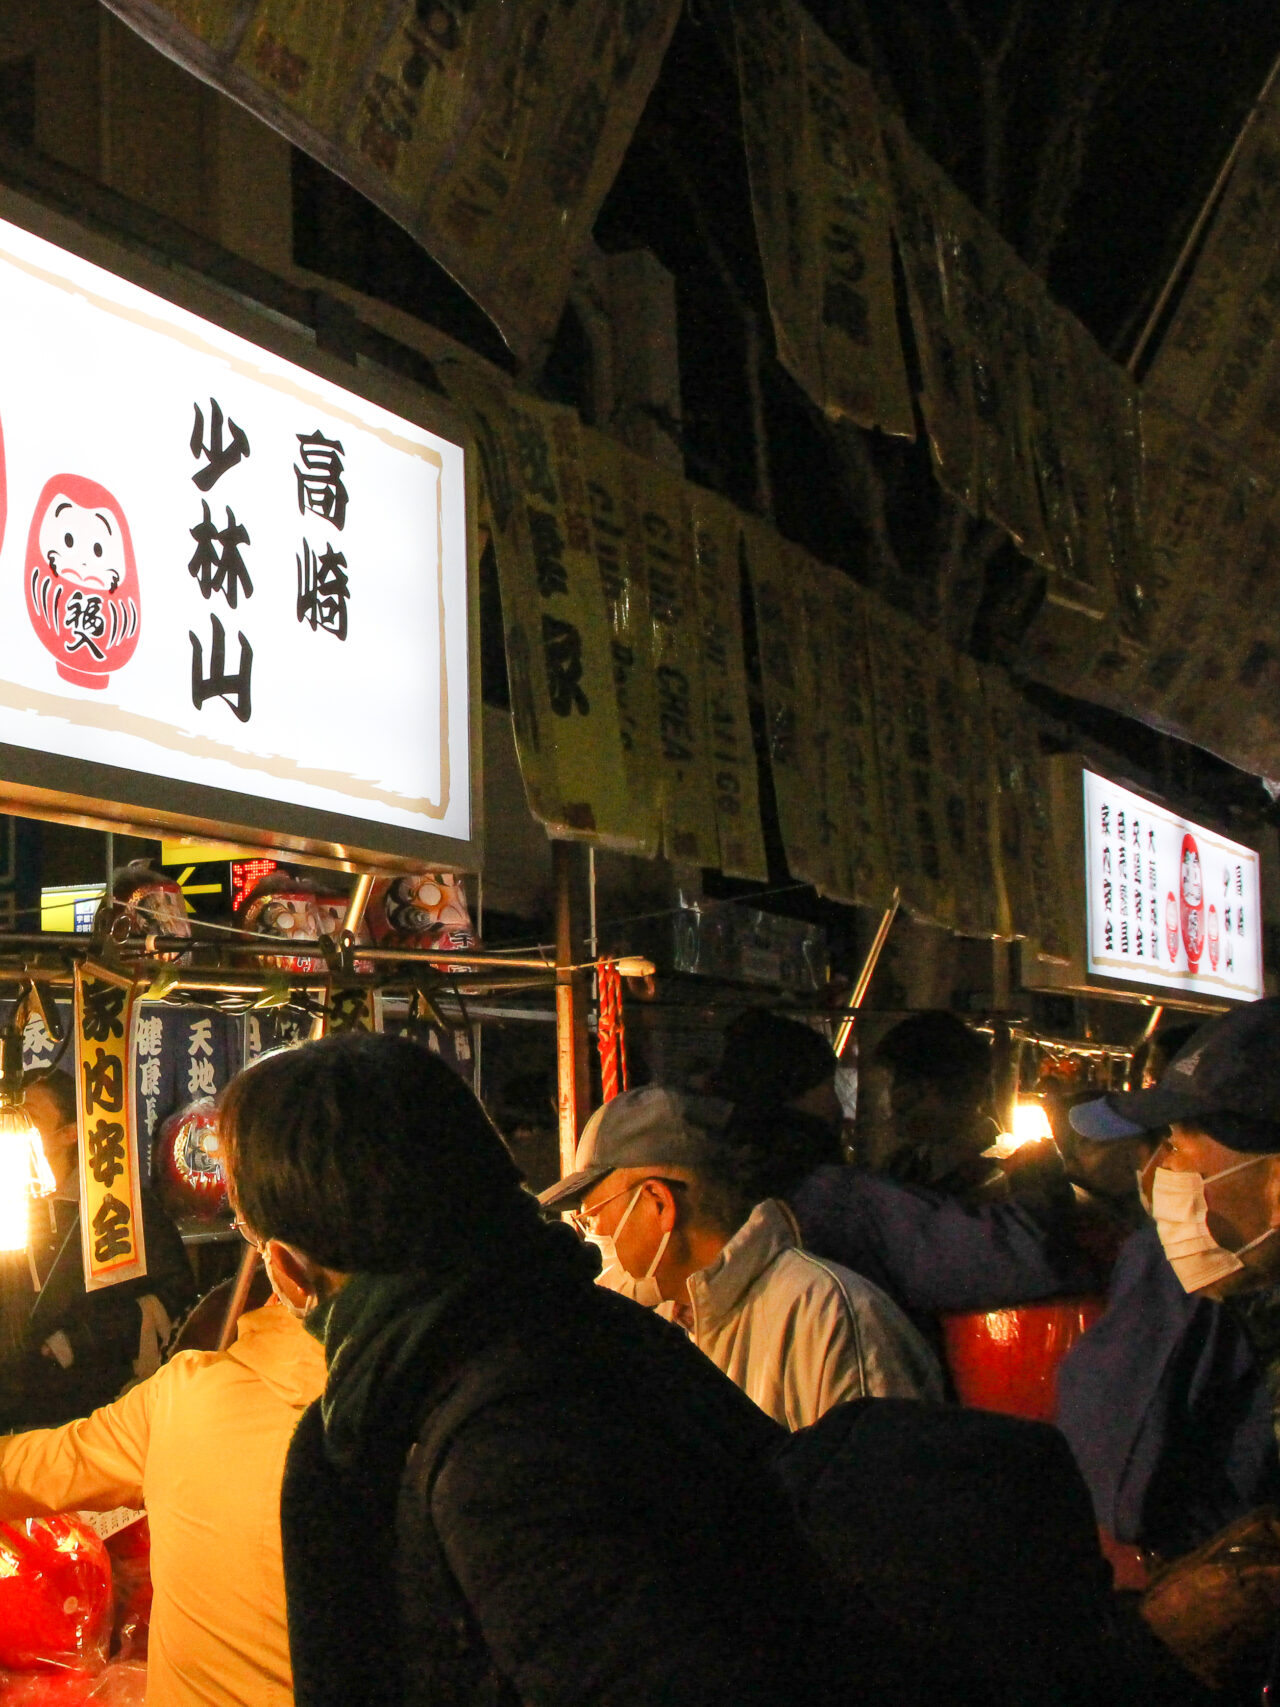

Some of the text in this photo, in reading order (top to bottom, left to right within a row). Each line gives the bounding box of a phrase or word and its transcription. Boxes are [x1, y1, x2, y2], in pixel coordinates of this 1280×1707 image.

[188, 397, 253, 723] 少林山
[294, 430, 351, 642] 高崎
[81, 978, 132, 1263] 家内安全
